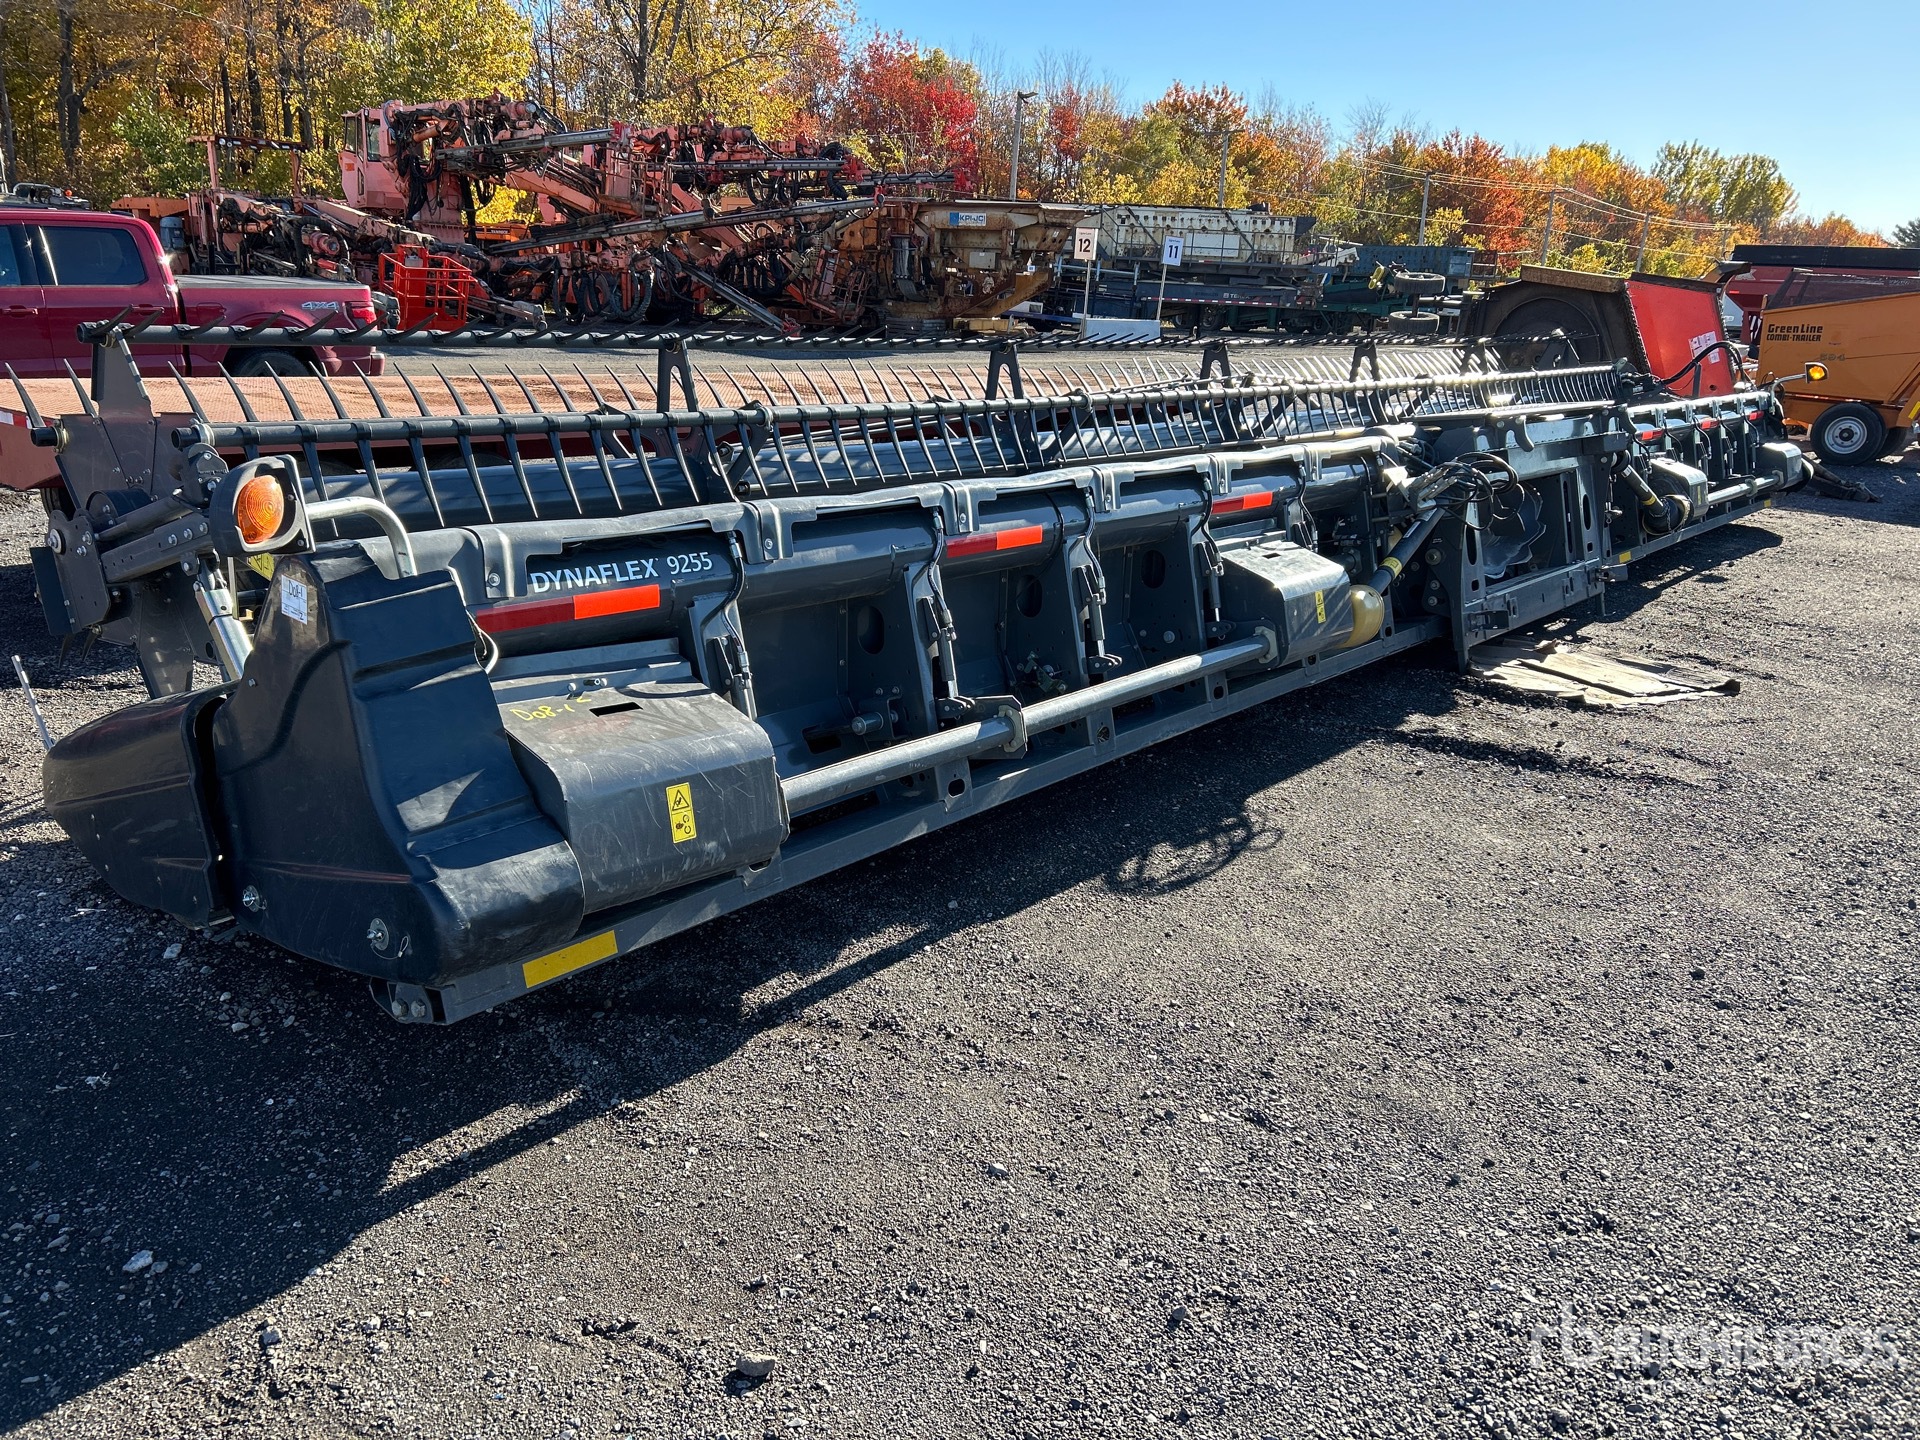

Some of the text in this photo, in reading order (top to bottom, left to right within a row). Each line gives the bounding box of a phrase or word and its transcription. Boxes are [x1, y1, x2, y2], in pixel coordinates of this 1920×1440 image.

[1078, 238, 1091, 253] 12
[1168, 245, 1179, 259] 11
[1766, 333, 1822, 342] COMBI-TRAILER
[530, 551, 713, 593] DYNAFLEX 9255
